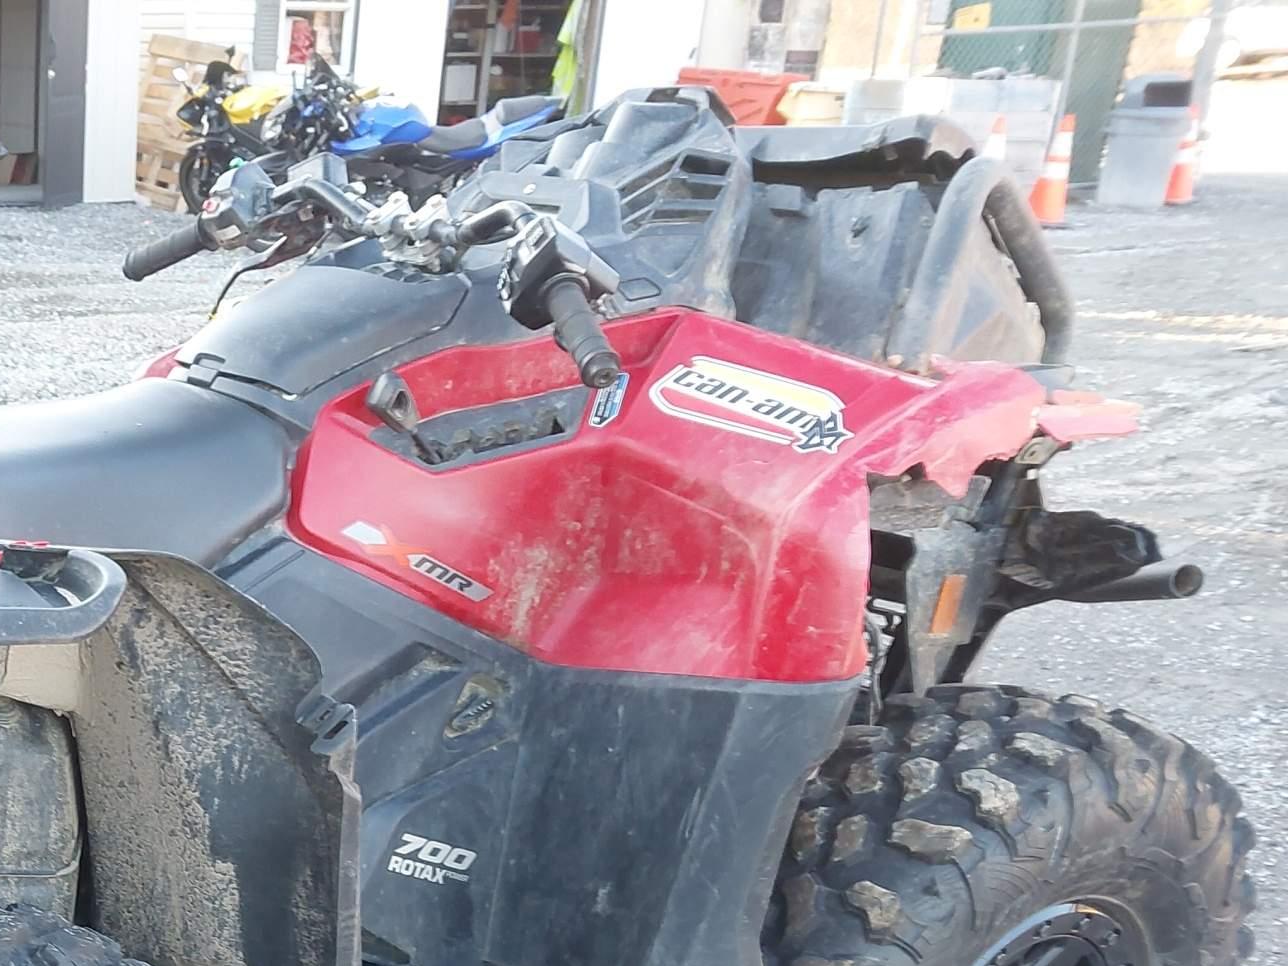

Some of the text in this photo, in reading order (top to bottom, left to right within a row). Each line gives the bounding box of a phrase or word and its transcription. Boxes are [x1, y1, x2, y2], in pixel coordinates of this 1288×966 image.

[672, 369, 821, 431] can-am
[387, 855, 445, 885] ROTAX
[394, 833, 477, 871] 700
